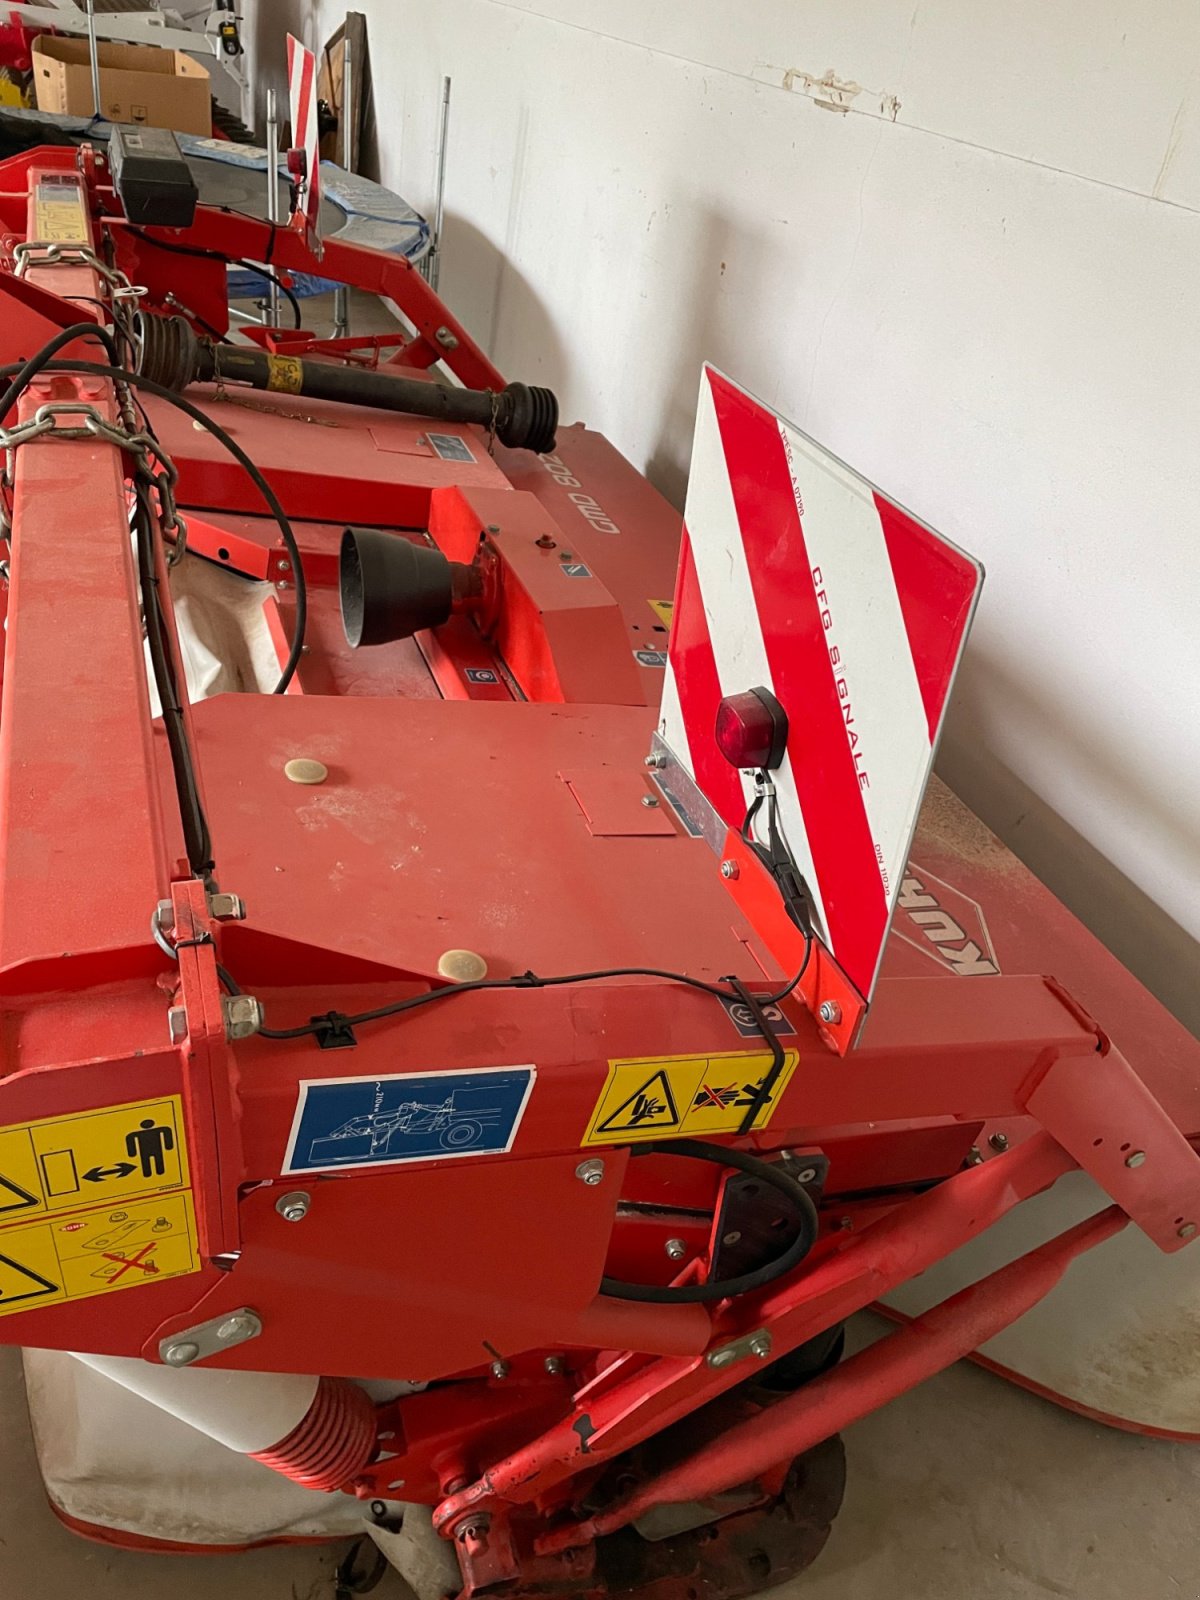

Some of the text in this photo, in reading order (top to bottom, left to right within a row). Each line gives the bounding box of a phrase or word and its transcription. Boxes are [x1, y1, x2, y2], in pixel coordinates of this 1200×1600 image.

[537, 452, 621, 534] GMD 802
[792, 476, 797, 485] A
[812, 566, 870, 791] CFG SIGNALE
[874, 843, 884, 864] DIN
[896, 868, 1000, 977] KUH
